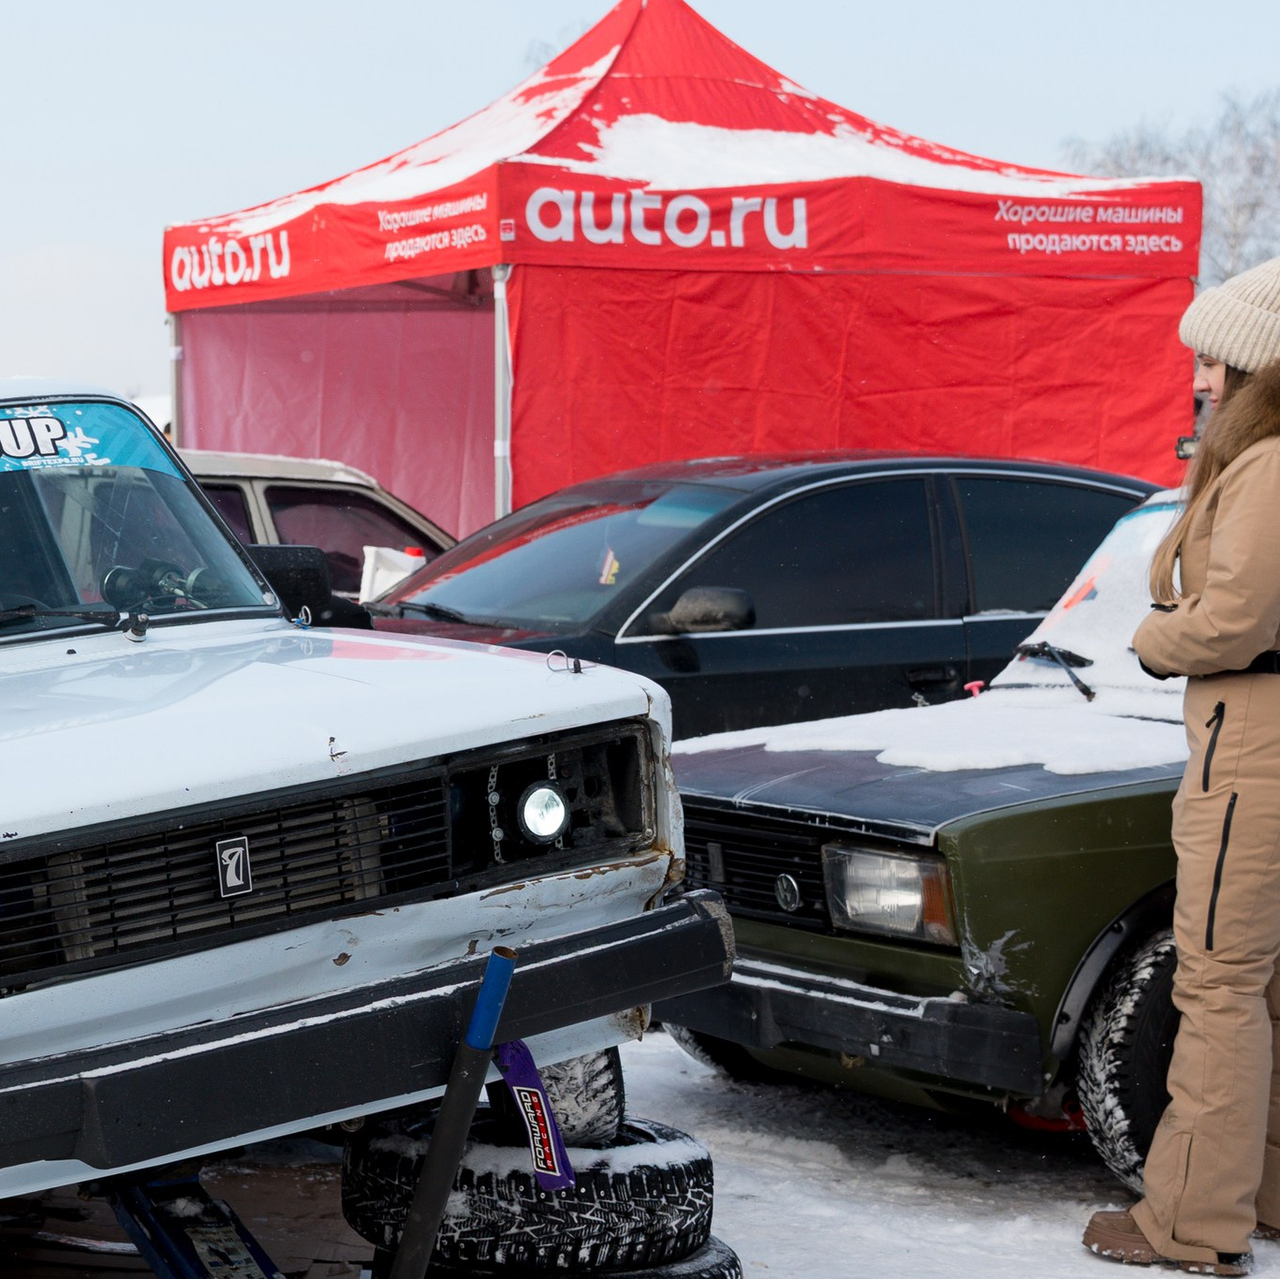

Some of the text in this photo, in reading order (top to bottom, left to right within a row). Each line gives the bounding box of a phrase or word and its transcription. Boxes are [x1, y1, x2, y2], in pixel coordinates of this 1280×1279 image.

[378, 192, 487, 233] Хорошие машины
[525, 186, 808, 249] auto.ru
[995, 200, 1183, 225] Хорошие машины
[171, 229, 290, 292] auto.ru
[384, 230, 450, 261] продаются
[451, 224, 487, 249] здесь
[1007, 232, 1183, 254] продаются здесь
[520, 1091, 548, 1169] FORWARD
[531, 1095, 554, 1168] RACING
